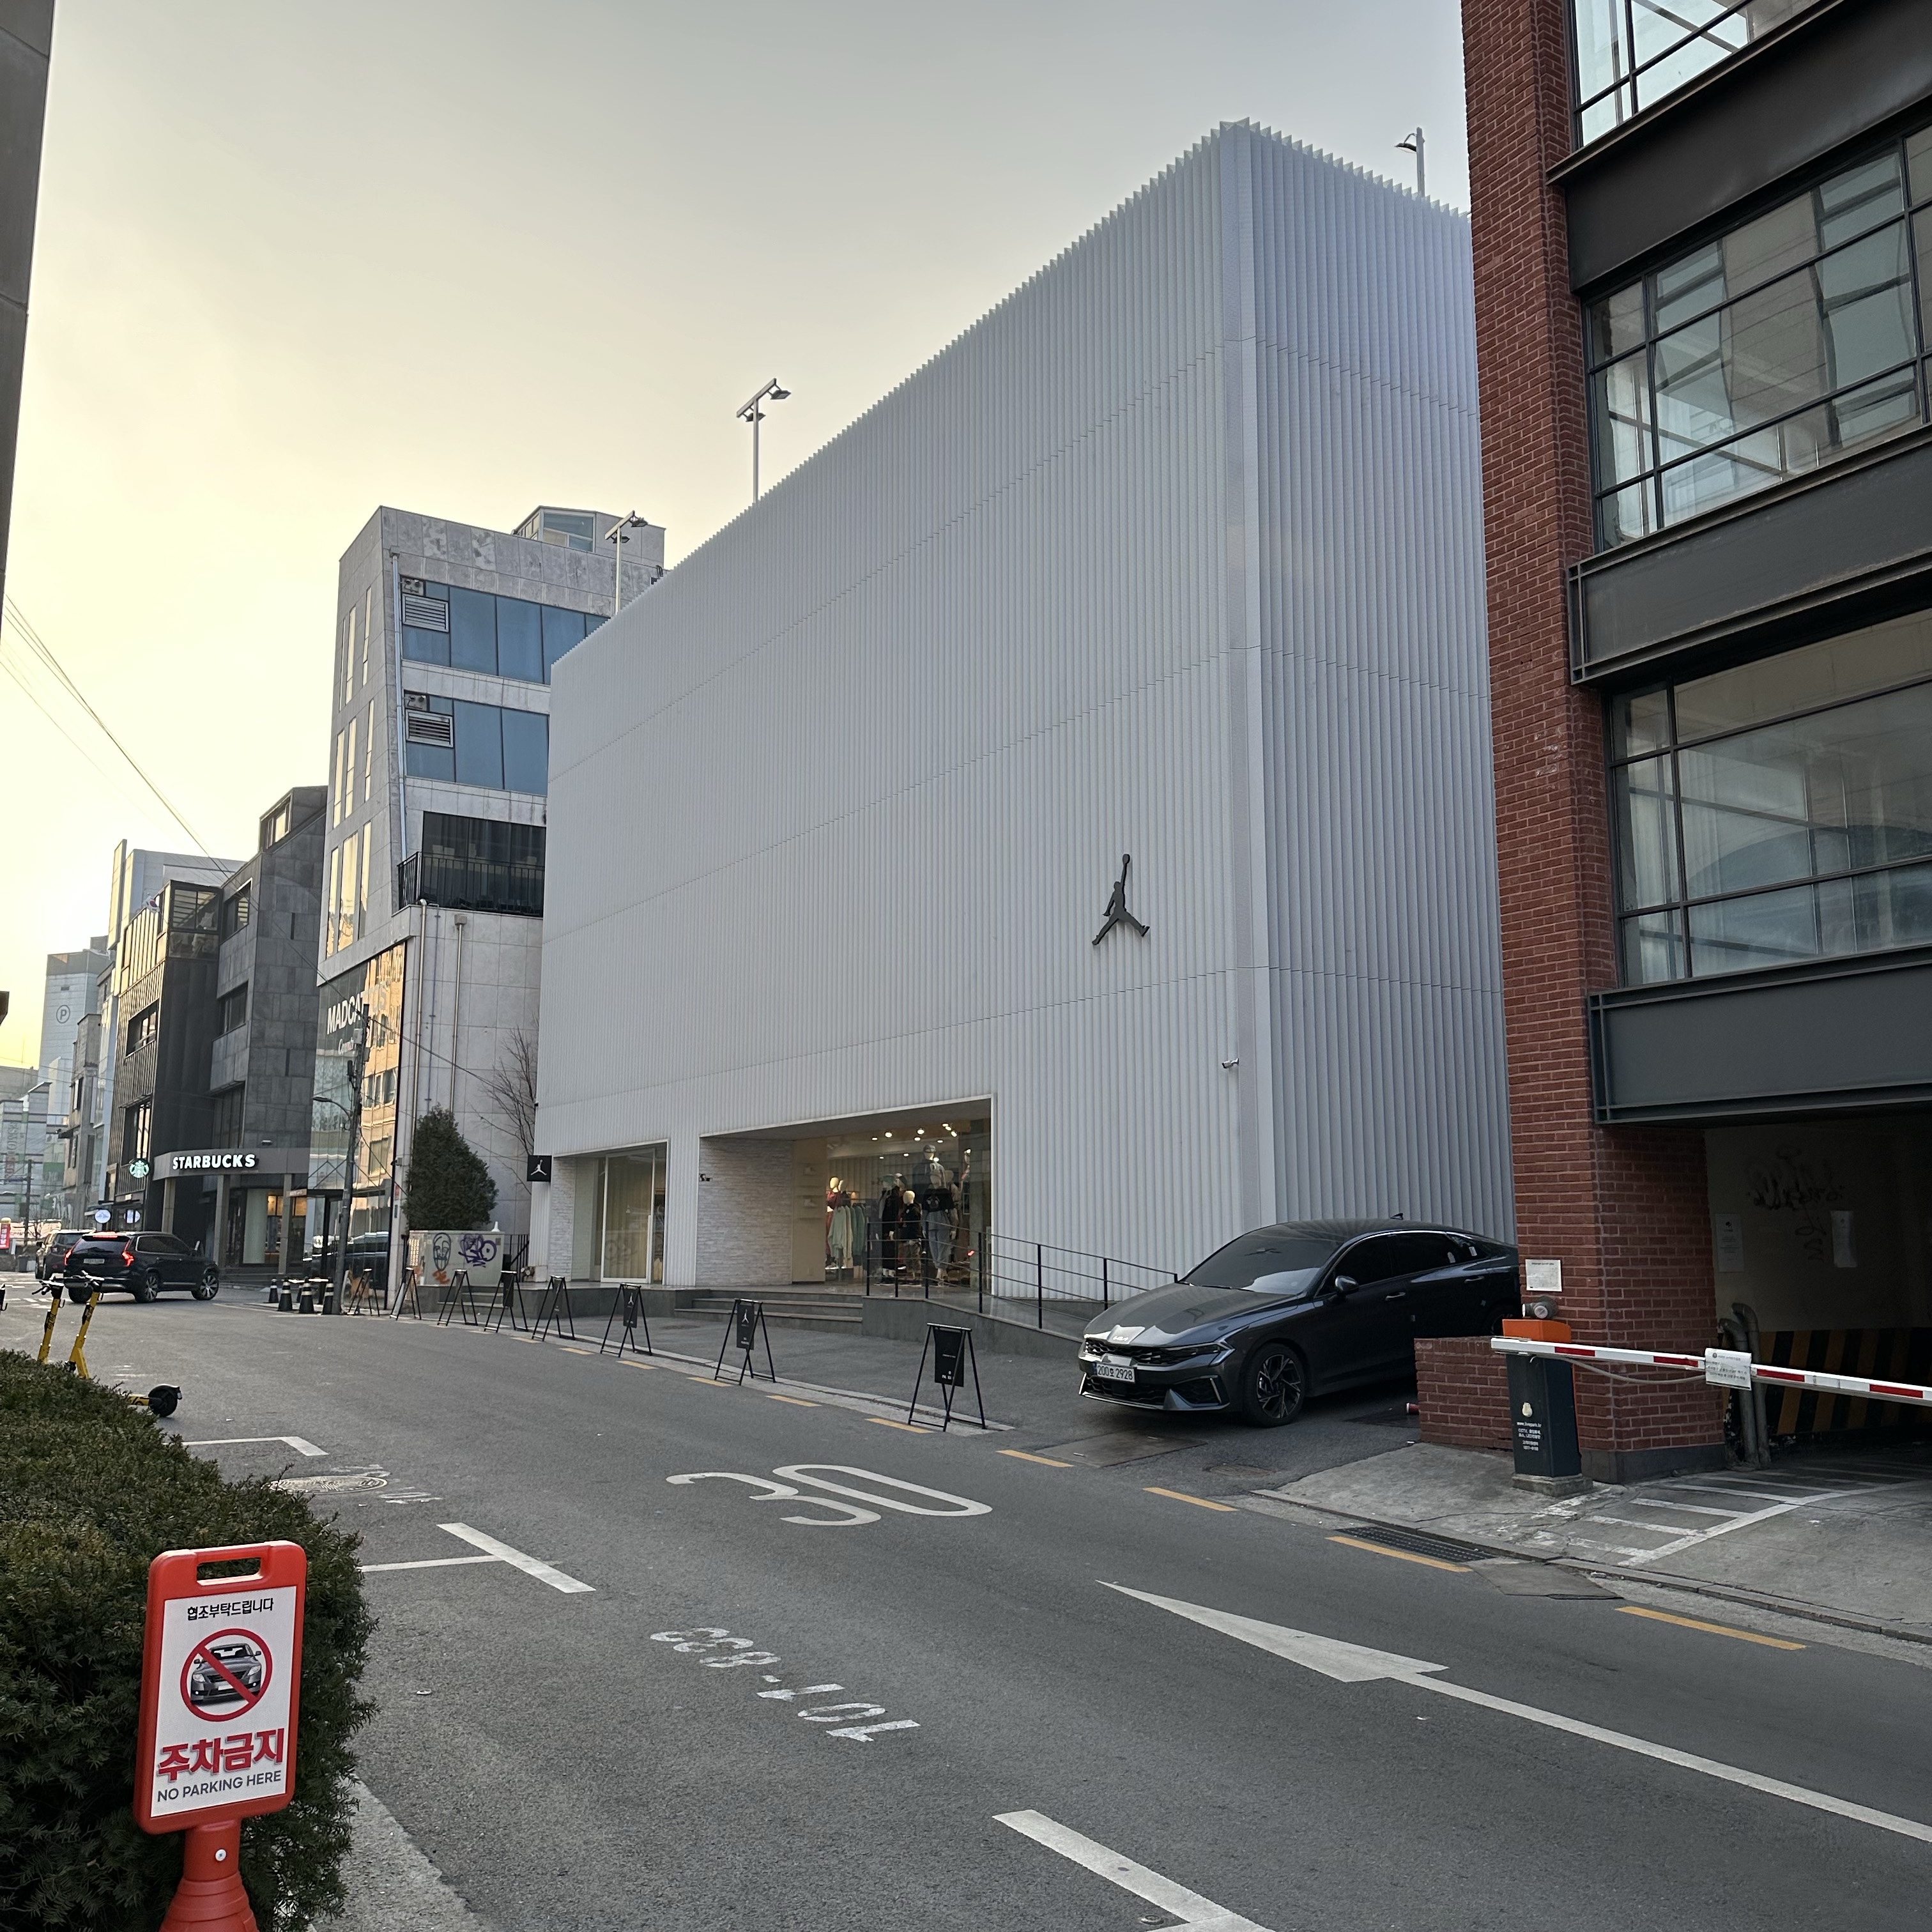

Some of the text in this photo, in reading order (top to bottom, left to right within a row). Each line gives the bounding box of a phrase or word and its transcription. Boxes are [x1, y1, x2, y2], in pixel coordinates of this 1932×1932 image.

[172, 1154, 256, 1170] STARBUCKS
[1116, 1368, 1133, 1381] 2928
[665, 1464, 993, 1526] 30
[187, 1597, 274, 1621] 협조부탁드립니다
[157, 1727, 285, 1782] 주차금지
[157, 1769, 282, 1802] NO PARKING HERE
